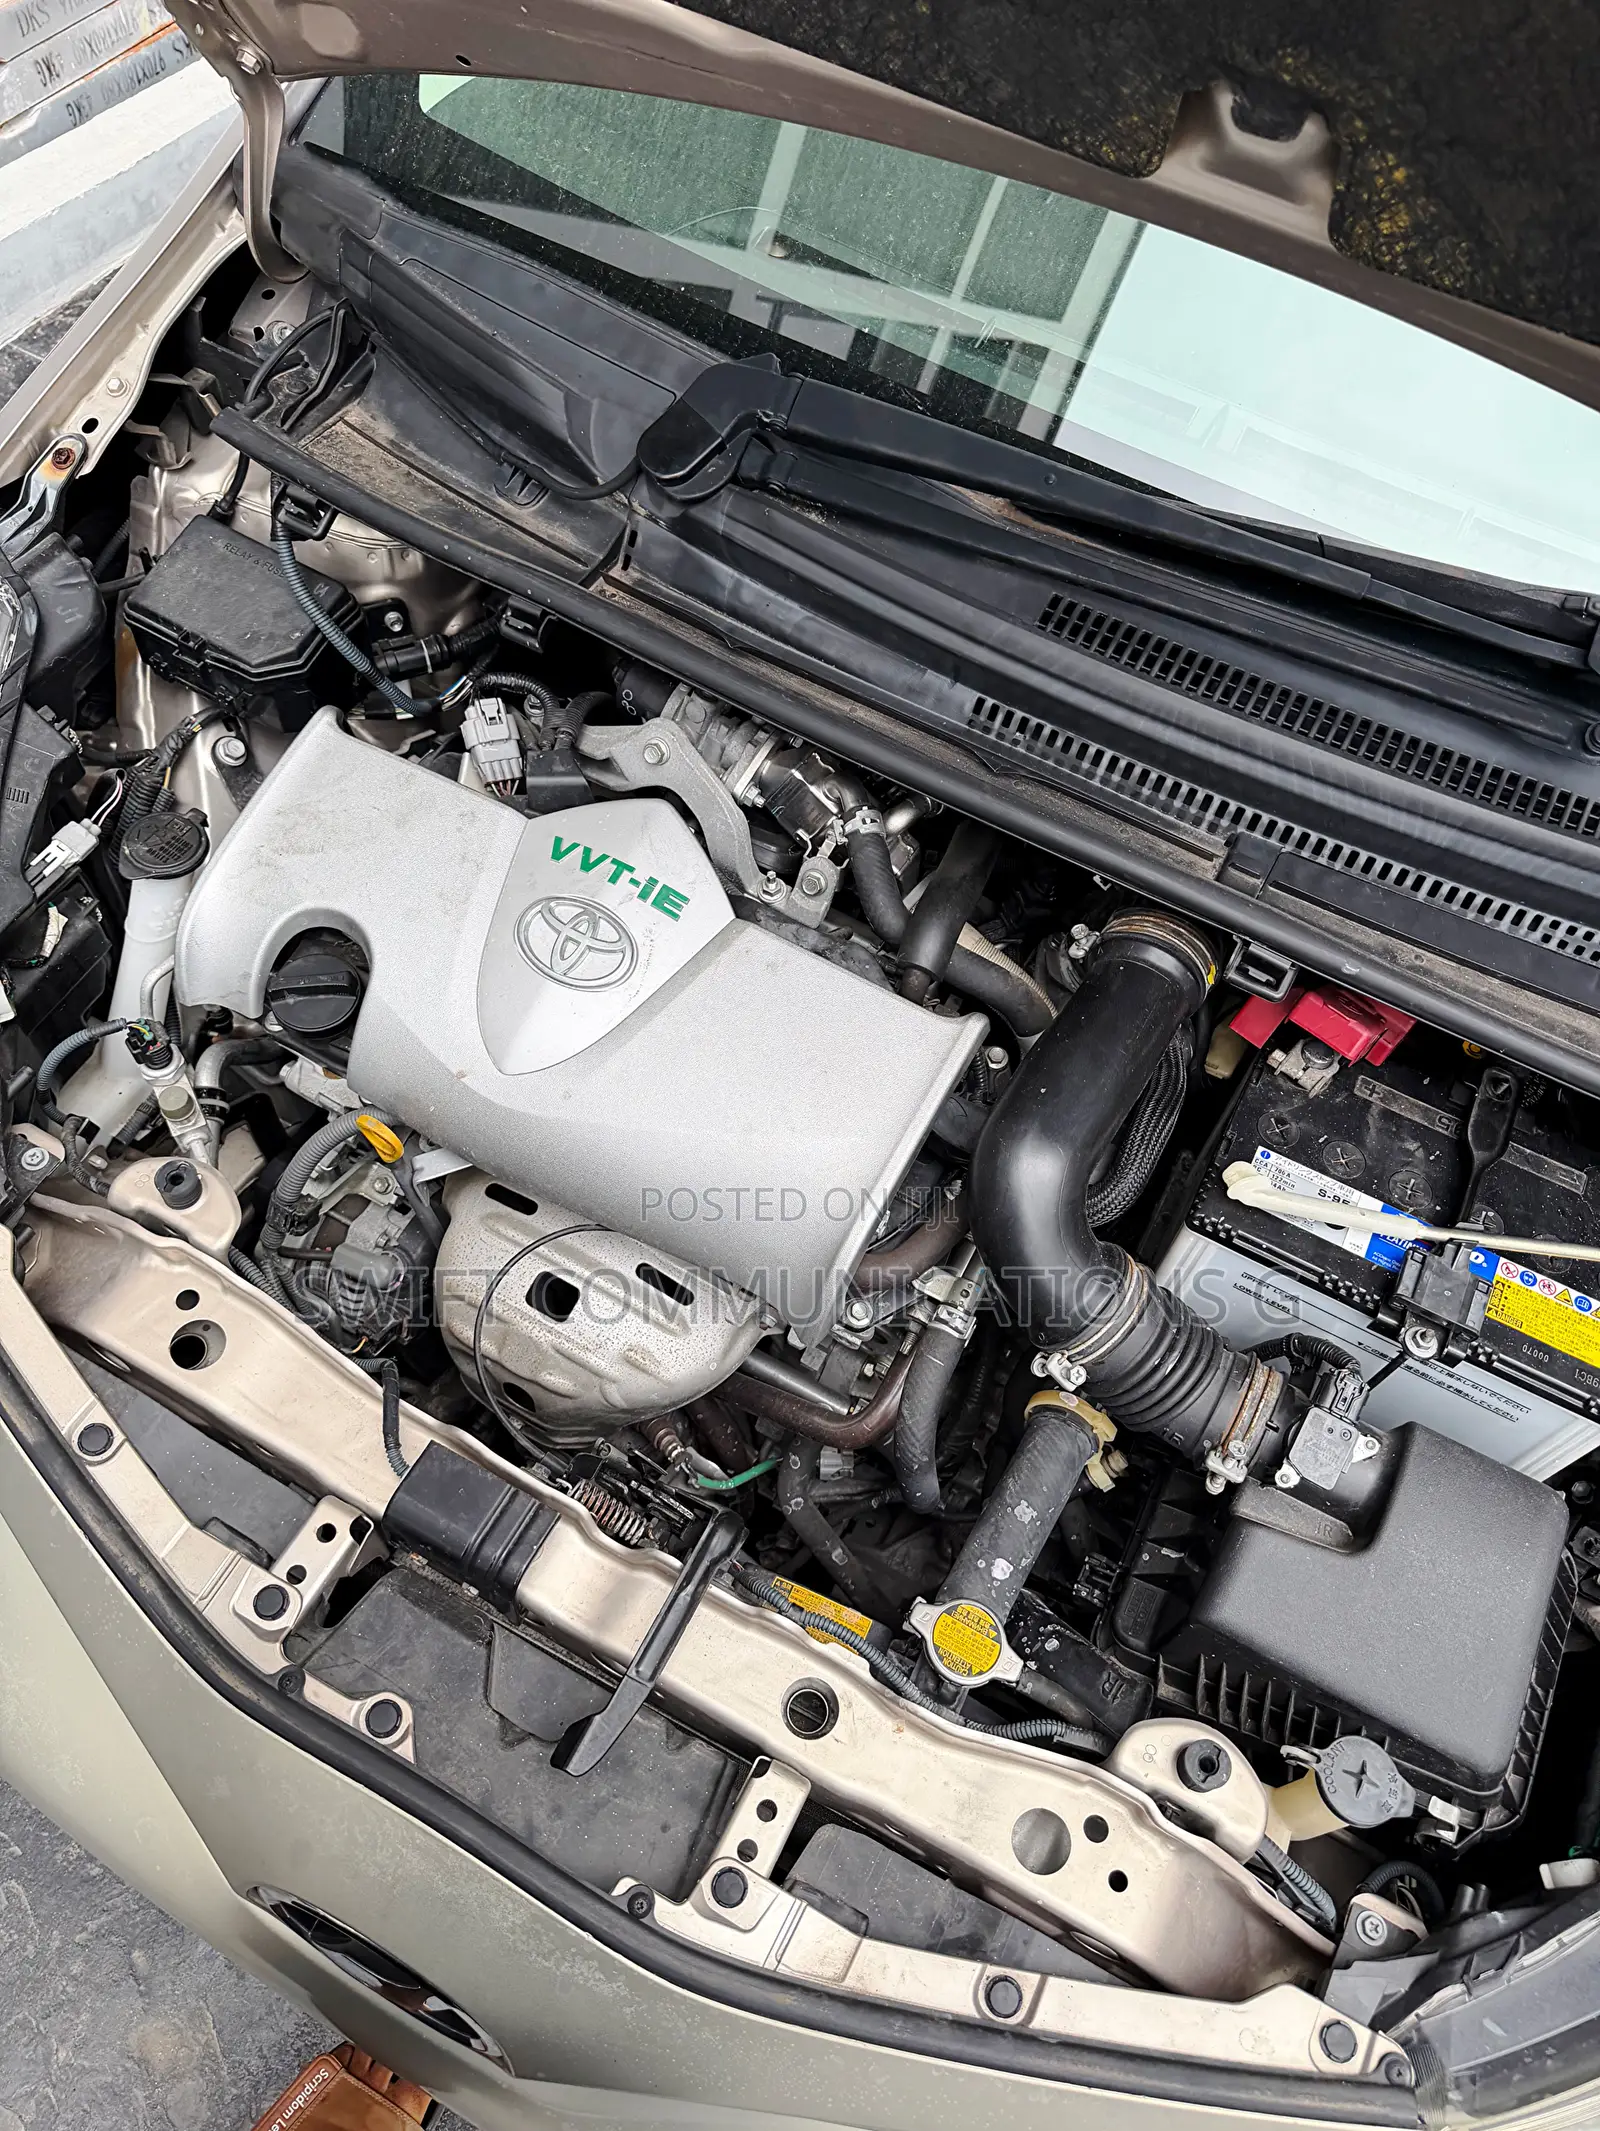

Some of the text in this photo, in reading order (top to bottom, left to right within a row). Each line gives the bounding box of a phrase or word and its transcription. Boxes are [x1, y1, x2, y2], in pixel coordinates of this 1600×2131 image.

[222, 541, 254, 561] RELAY
[549, 835, 691, 922] VVT-iE
[1233, 1282, 1291, 1313] LOWER LEVEL
[1240, 1272, 1300, 1304] UPPER LEVEL
[1495, 1311, 1523, 1328] DANGER
[1523, 1344, 1549, 1361] 00070
[936, 1646, 971, 1669] ATTENTION
[940, 1656, 969, 1676] CAUTION
[1322, 1739, 1346, 1794] COOLANT
[282, 2068, 329, 2119] Scripidom
